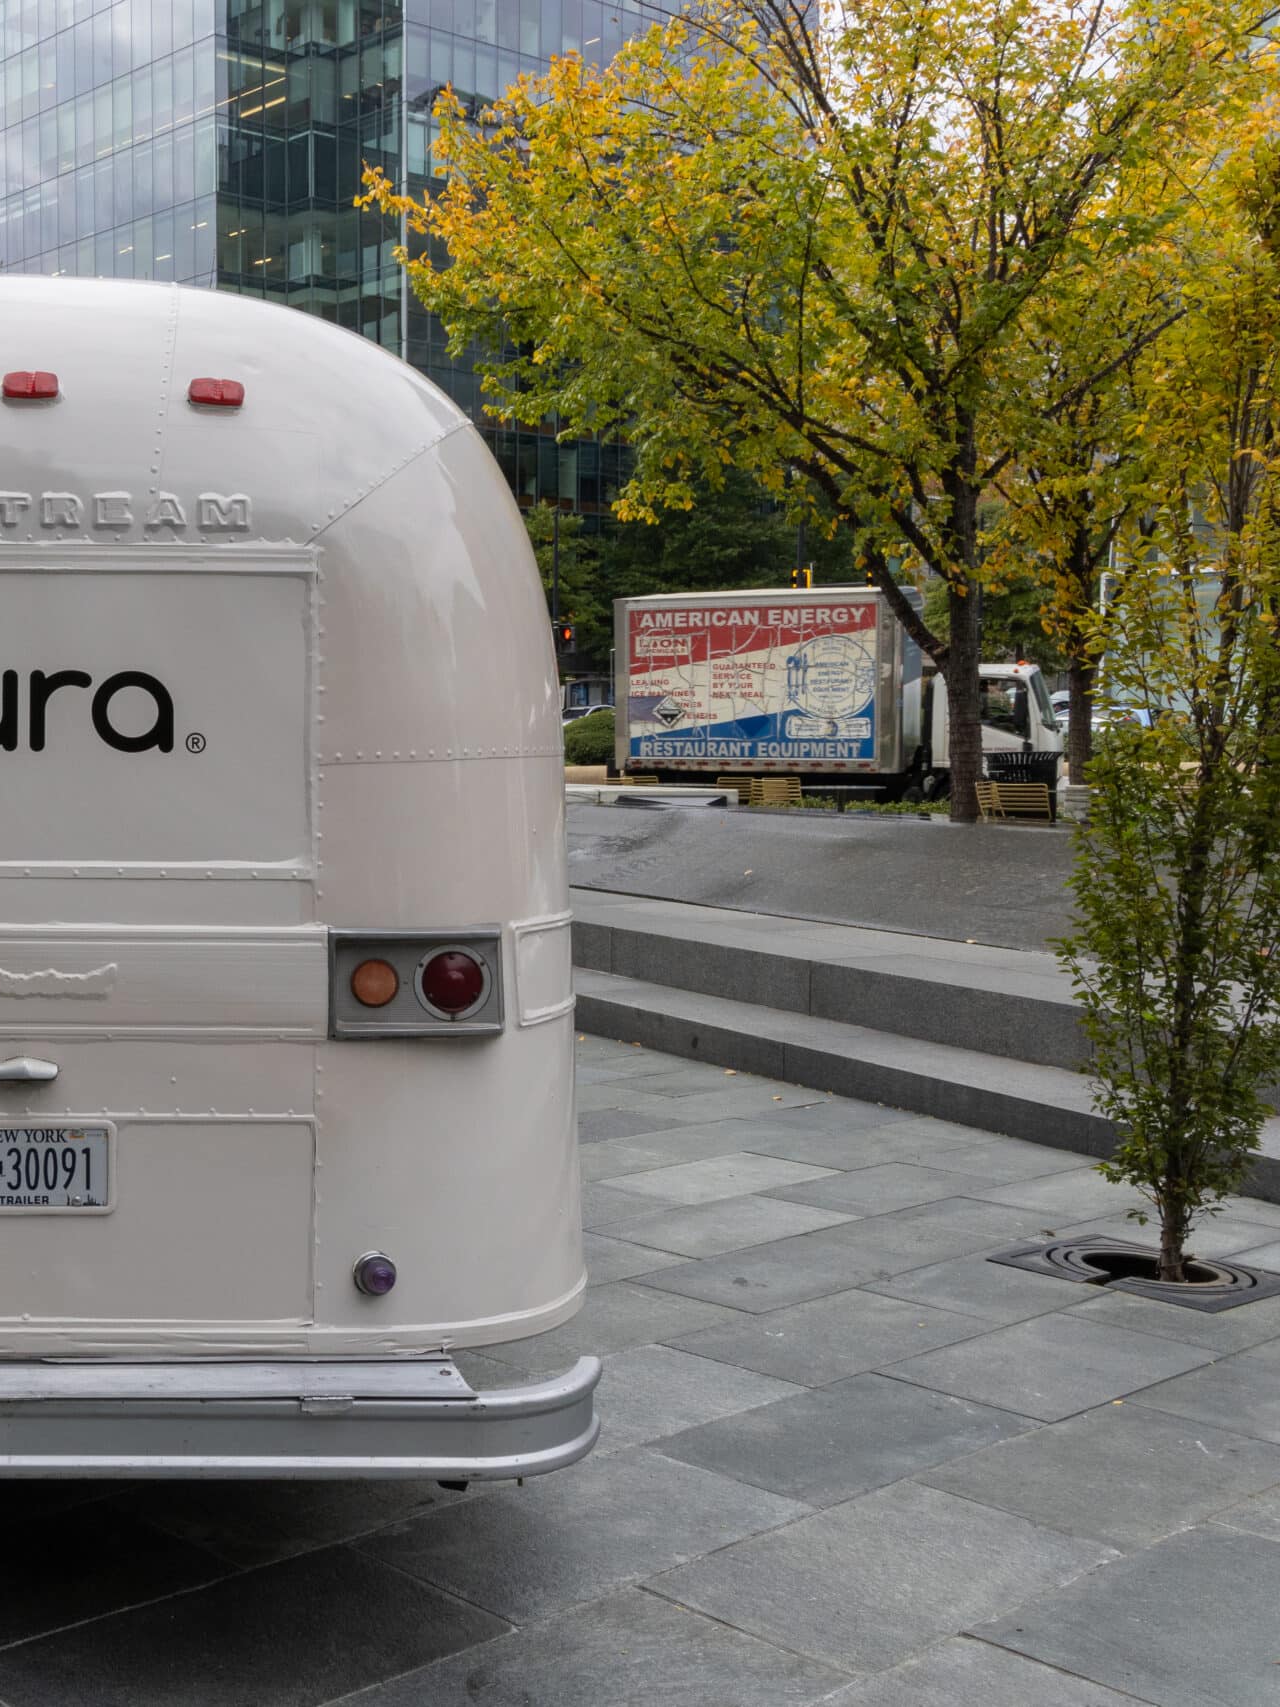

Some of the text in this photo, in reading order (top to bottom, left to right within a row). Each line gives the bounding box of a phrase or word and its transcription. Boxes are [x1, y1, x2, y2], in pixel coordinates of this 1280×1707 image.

[640, 607, 866, 627] AMERICAN ENERGY
[712, 662, 776, 670] GUARANTEED
[631, 690, 643, 698] ICE
[740, 690, 764, 699] MEAL
[640, 740, 861, 757] RESTAURANT EQUIPMENT
[24, 1129, 68, 1144] YORK
[6, 1147, 91, 1191] 30091
[0, 1195, 50, 1205] TRAILER
